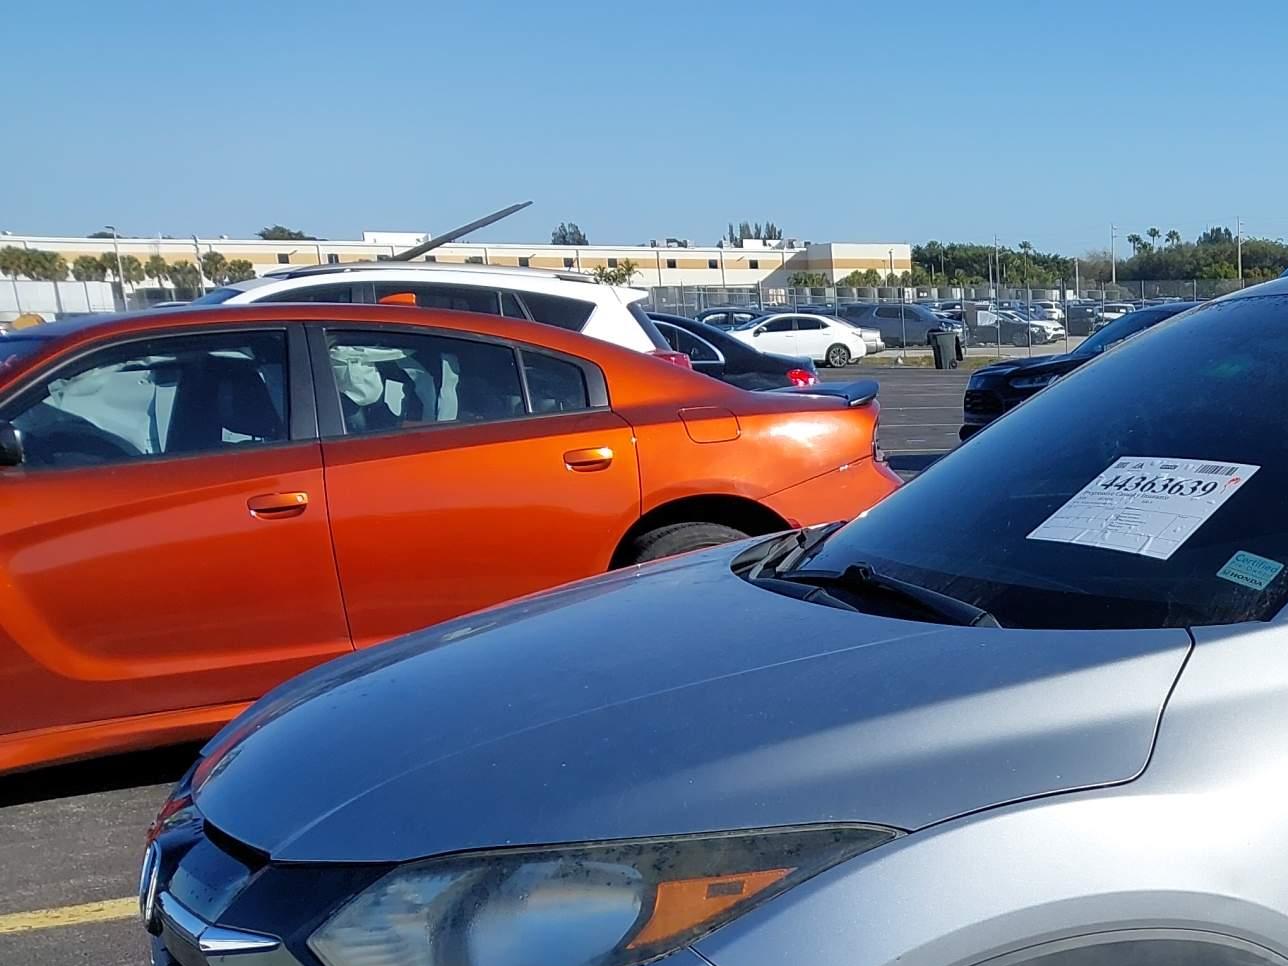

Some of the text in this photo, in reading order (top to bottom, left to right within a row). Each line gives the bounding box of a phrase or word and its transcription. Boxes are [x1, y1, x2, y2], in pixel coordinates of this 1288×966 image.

[1101, 475, 1219, 498] 44363639
[1235, 554, 1279, 573] Certified
[1230, 572, 1264, 587] HONDA
